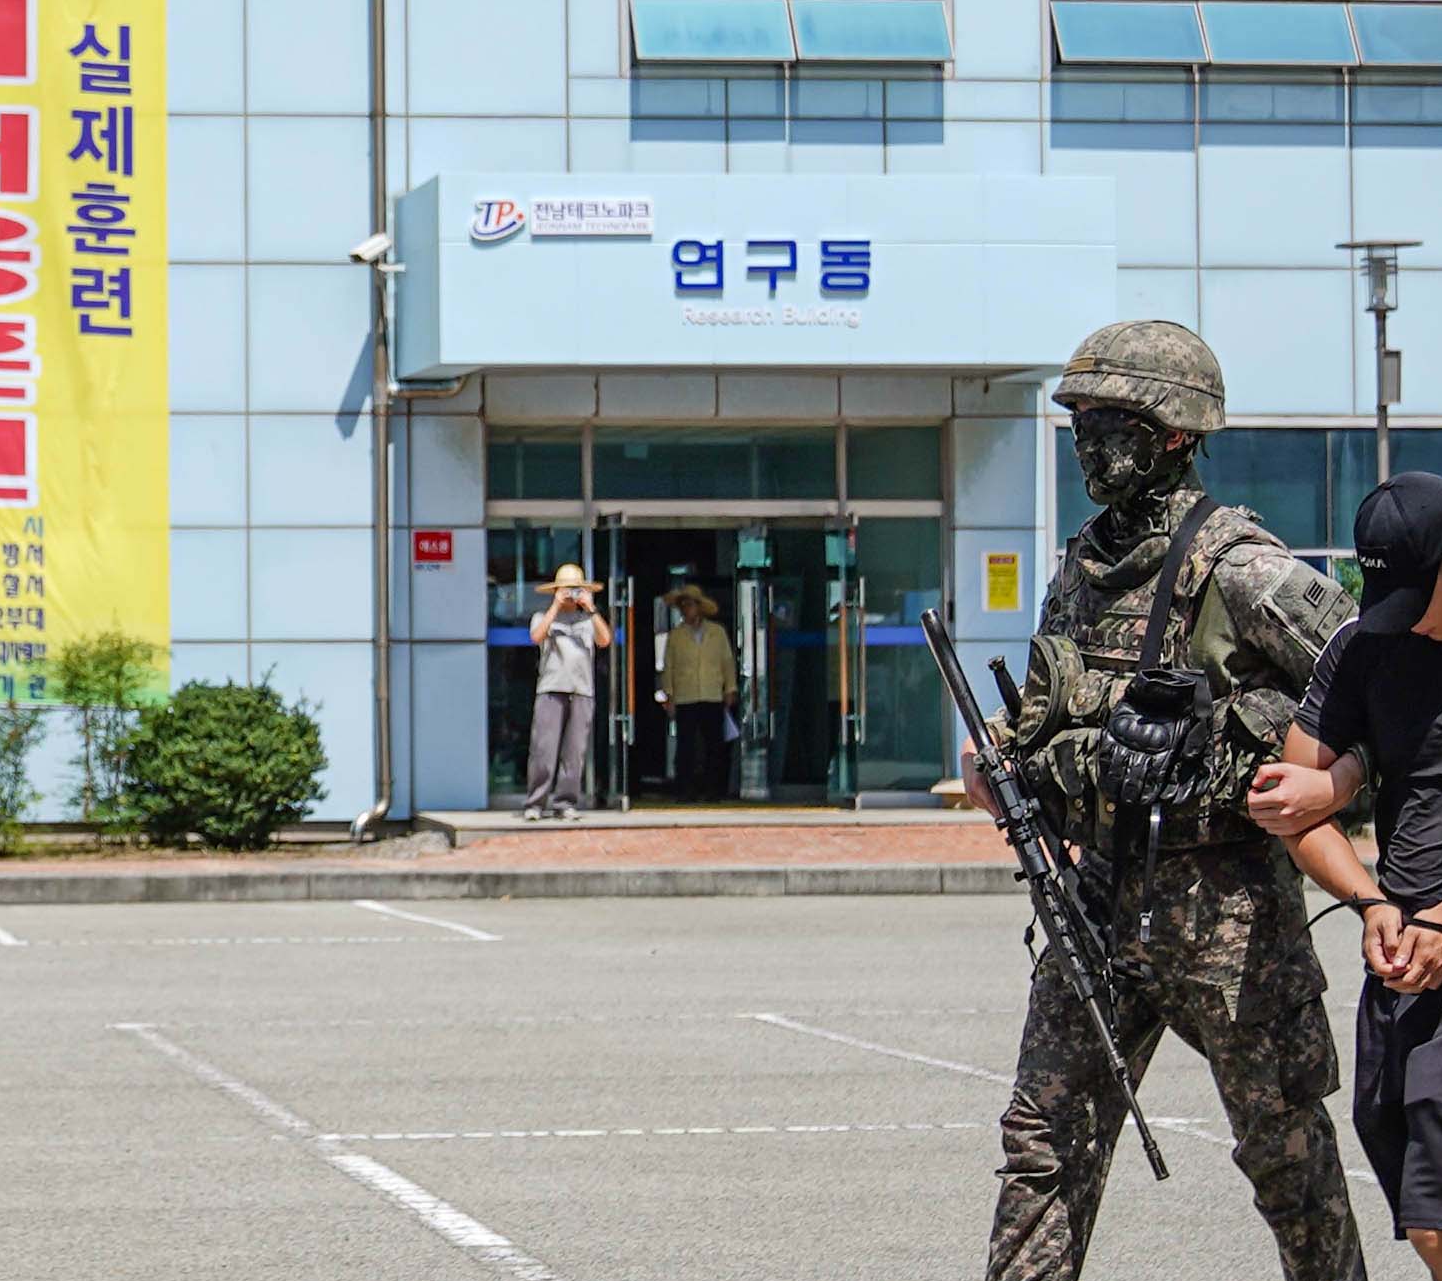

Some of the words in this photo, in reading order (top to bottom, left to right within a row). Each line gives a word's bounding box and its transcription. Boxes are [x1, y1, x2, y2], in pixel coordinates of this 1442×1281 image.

[68, 23, 135, 337] 실제훈련
[533, 201, 651, 221] 전남테크노파크
[672, 240, 871, 292] 연구동
[682, 306, 774, 327] Research
[782, 306, 862, 329] Building
